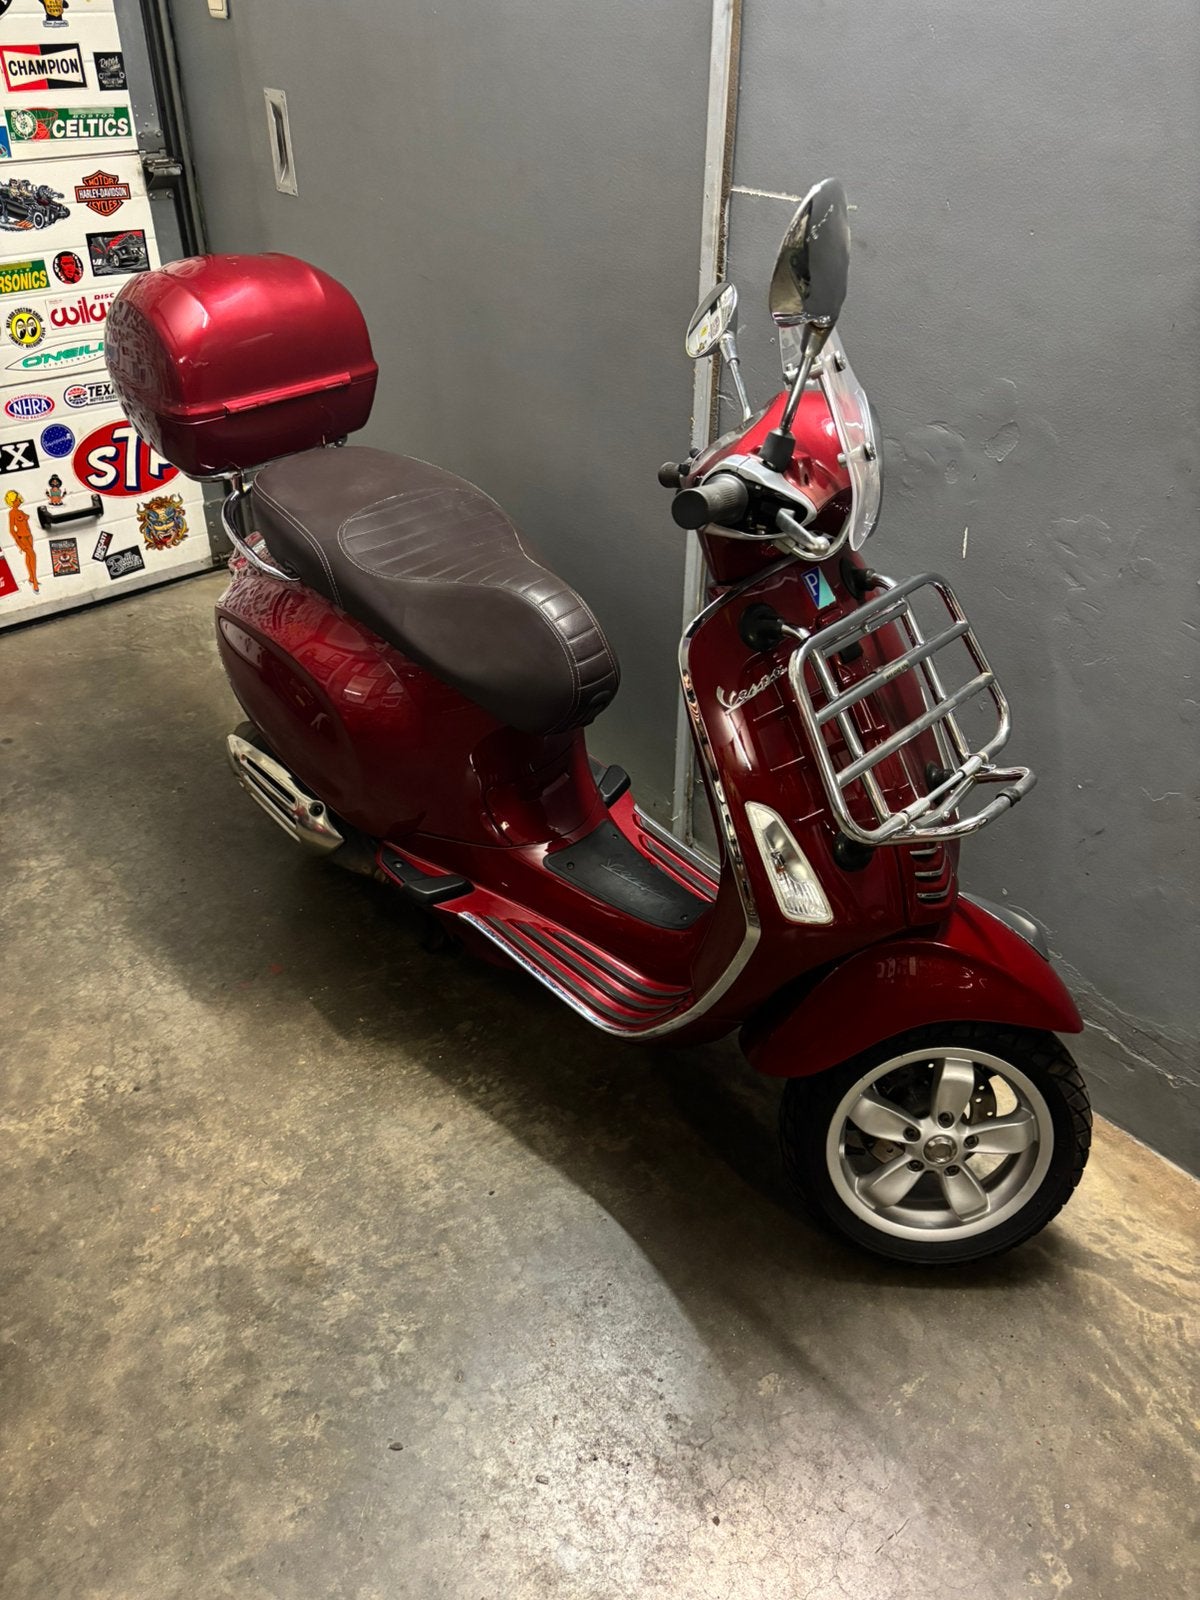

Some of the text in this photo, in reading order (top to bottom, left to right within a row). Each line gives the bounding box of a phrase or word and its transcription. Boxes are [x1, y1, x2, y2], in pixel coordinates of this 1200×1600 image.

[8, 58, 80, 76] CHAMPION
[52, 118, 129, 138] CELTICS
[88, 174, 115, 186] MOTOR
[79, 187, 127, 199] HARLEY-DAVIDSON
[91, 199, 118, 212] CYCLES
[94, 292, 115, 300] DISC
[13, 399, 48, 415] NHRA
[0, 441, 34, 471] X
[94, 532, 108, 560] DUCATI
[804, 573, 819, 597] P
[716, 664, 788, 715] Vespa
